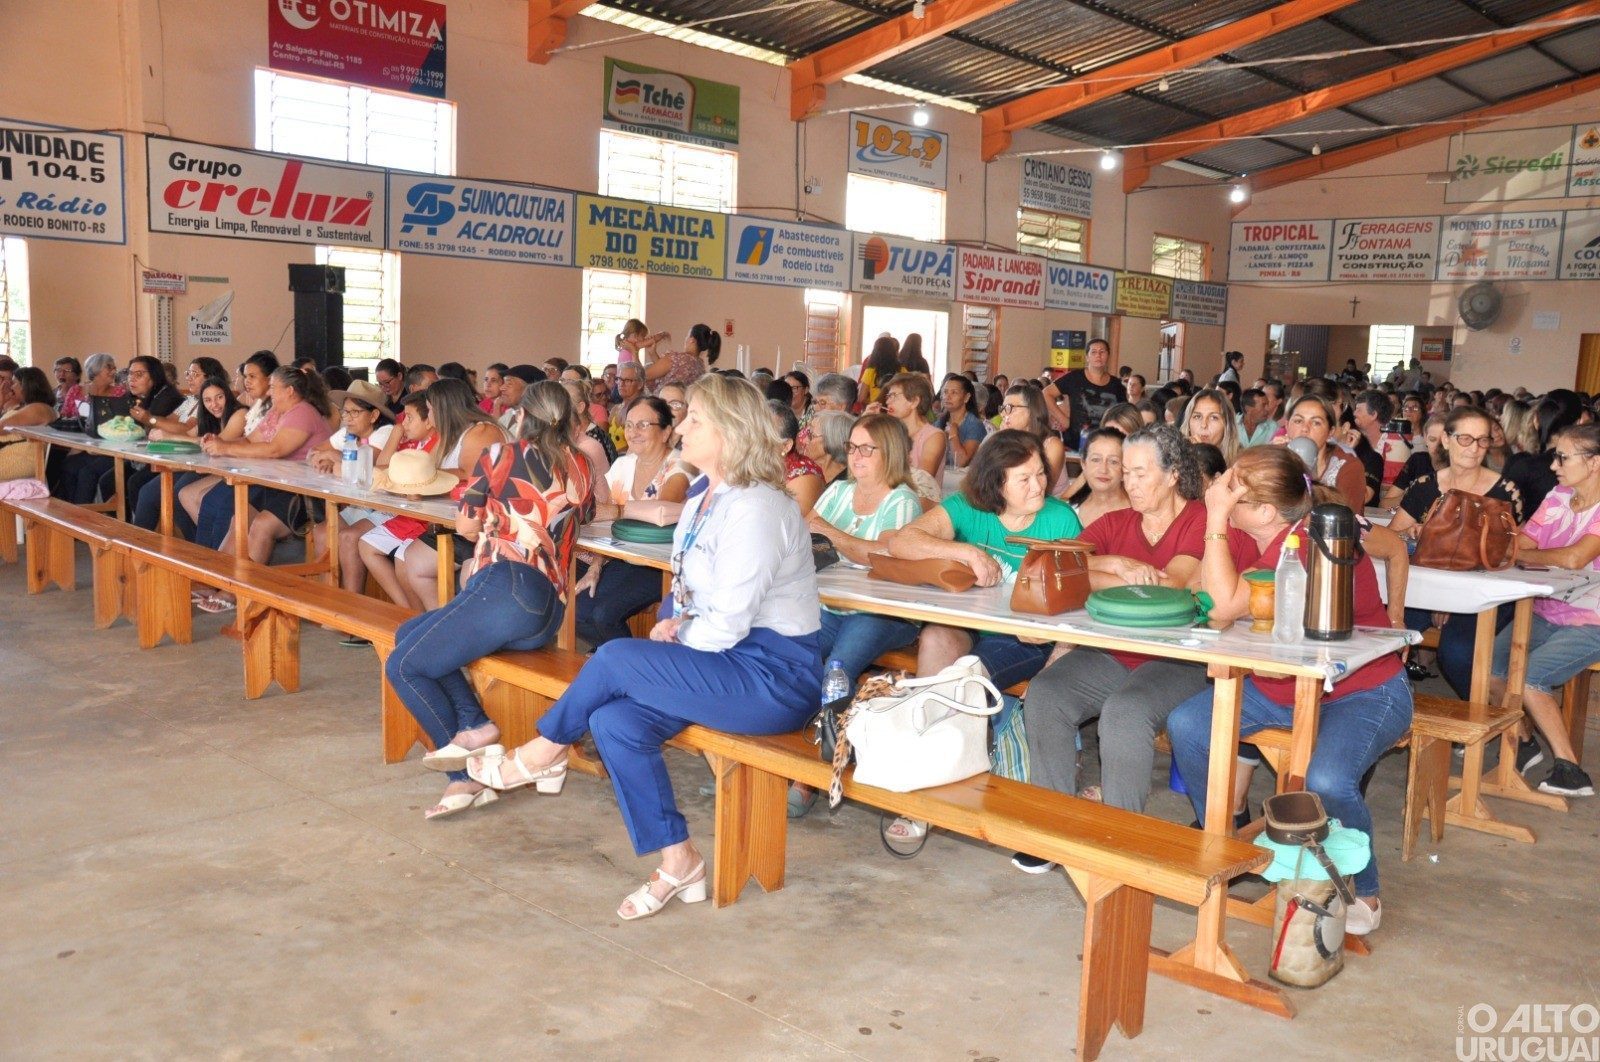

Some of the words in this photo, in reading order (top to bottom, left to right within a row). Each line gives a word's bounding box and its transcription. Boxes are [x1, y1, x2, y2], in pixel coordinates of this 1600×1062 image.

[329, 0, 443, 42] OTIMIZA
[272, 41, 284, 50] Av
[285, 43, 318, 57] Salgado
[319, 49, 339, 61] Filho
[272, 50, 300, 63] Centro
[643, 83, 685, 111] Tchê
[642, 105, 683, 121] FARMÁCIAS
[620, 123, 663, 138] RODEIO
[856, 120, 941, 161] 102.9
[28, 160, 106, 184] 104.5
[168, 151, 242, 180] Grupo
[1024, 158, 1066, 184] CRISTIANO
[1068, 168, 1092, 189] GESSO
[1484, 152, 1564, 175] Sicredi
[163, 158, 373, 227] creluz
[16, 191, 107, 217] Rádio
[458, 187, 565, 223] SUINOCULTURA
[3, 213, 44, 229] RODEIO
[168, 212, 210, 231] Energia
[215, 216, 248, 234] Limpa,
[251, 220, 301, 237] Renovável
[306, 228, 312, 238] e
[317, 226, 373, 243] Sustentável.
[589, 204, 715, 239] MECÂNICA
[1450, 220, 1491, 231] MOINHO
[1495, 219, 1524, 230] TRES
[1529, 218, 1557, 229] LTDA
[457, 220, 563, 248] ACADROLLI
[779, 229, 840, 246] Abastecedora
[1243, 223, 1319, 242] TROPICAL
[1339, 221, 1433, 250] FERRAGENS
[1351, 235, 1412, 250] FONTANA
[489, 248, 517, 257] RODEIO
[518, 250, 546, 261] BONITO
[554, 254, 563, 262] RS
[606, 231, 637, 255] DO
[651, 236, 699, 261] SIDI
[773, 244, 784, 254] de
[1254, 252, 1272, 260] CAFÉ
[1279, 252, 1308, 261] ALMOÇO
[1275, 243, 1326, 251] CONFEITARIA
[1337, 253, 1369, 261] TUDO
[1407, 252, 1431, 260] SUA
[590, 254, 613, 267] 3798
[617, 257, 639, 270] 1062
[647, 260, 680, 274] Rodeio
[683, 264, 713, 276] Bonito
[783, 259, 812, 271] Rodeio
[815, 263, 834, 274] Ltda
[889, 246, 955, 277] TUPÃ
[962, 252, 995, 270] PADARIA
[998, 257, 1003, 271] E
[1005, 258, 1042, 277] LANCHERIA
[1342, 261, 1424, 270] CONSTRUÇÃO
[1574, 262, 1597, 271] FORÇA
[901, 275, 924, 286] AUTO
[926, 277, 951, 288] PEÇAS
[963, 270, 1040, 296] Siprandi
[1259, 270, 1287, 278] PINHAL
